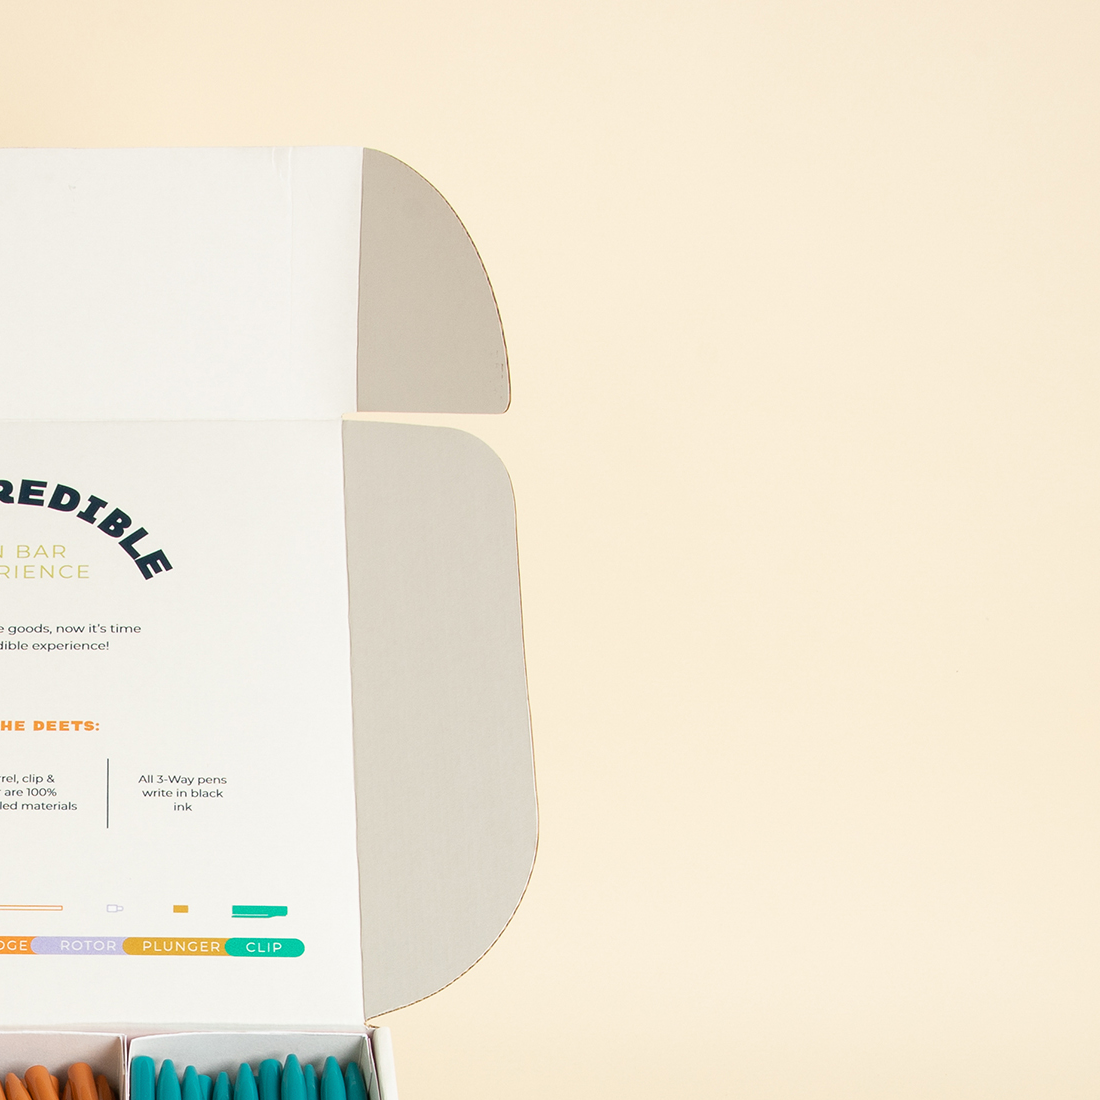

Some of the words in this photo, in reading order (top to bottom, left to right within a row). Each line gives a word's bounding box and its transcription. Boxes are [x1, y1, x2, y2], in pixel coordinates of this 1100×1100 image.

[17, 545, 65, 558] BAR
[7, 623, 53, 636] goods,
[56, 625, 86, 634] now
[88, 623, 107, 634] it’s
[110, 623, 142, 634] time
[31, 640, 109, 653] experience!
[33, 721, 99, 731] DEETS:
[21, 773, 44, 785] clip
[46, 774, 55, 784] &
[137, 774, 154, 784] All
[156, 774, 195, 786] 3-Way
[197, 776, 228, 786] pens
[4, 789, 24, 797] are
[26, 787, 58, 797] 100%
[141, 788, 174, 798] write
[176, 788, 188, 798] in
[190, 788, 224, 798] black
[21, 801, 78, 811] materials
[173, 802, 193, 812] ink
[60, 939, 117, 952] ROTOR
[142, 940, 221, 953] PLUNGER
[245, 941, 283, 953] CLIP
